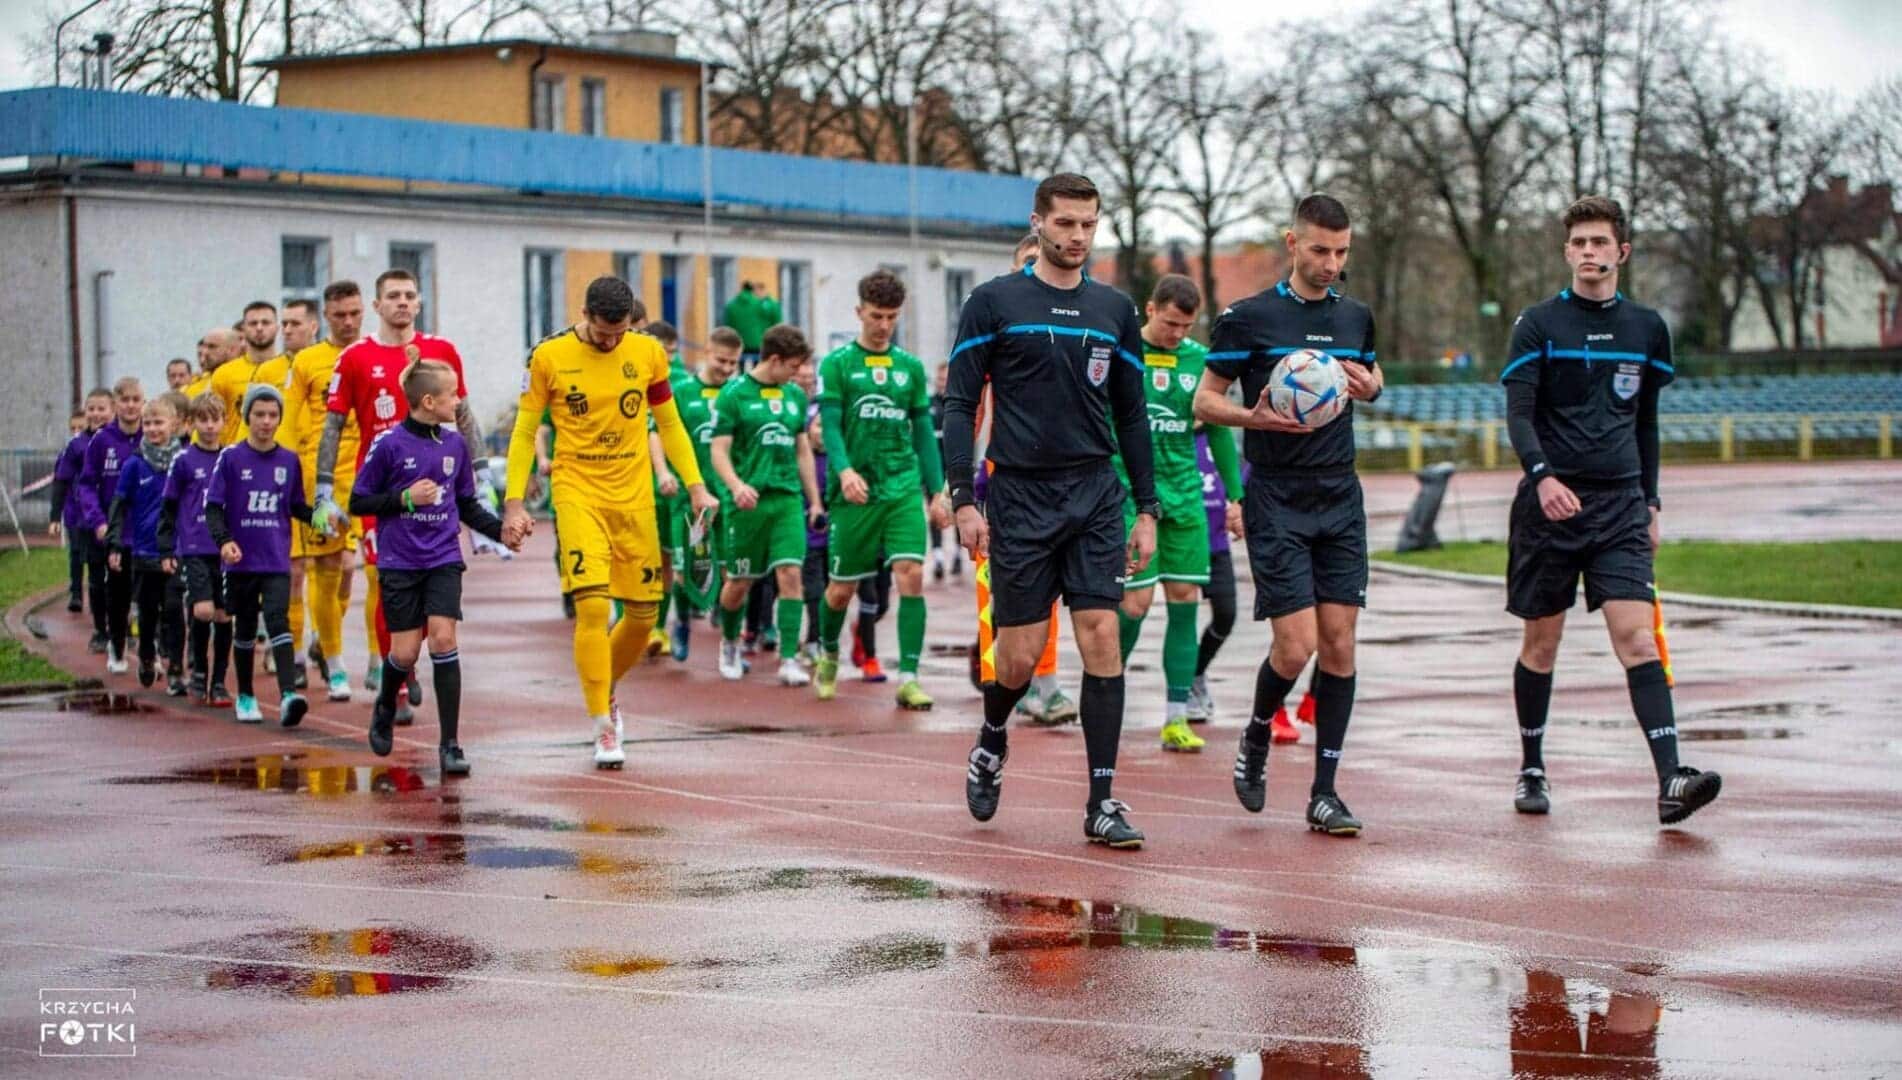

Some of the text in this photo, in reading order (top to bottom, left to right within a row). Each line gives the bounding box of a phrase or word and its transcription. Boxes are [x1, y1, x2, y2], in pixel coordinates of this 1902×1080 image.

[1147, 415, 1188, 432] nea
[247, 490, 279, 513] lit
[569, 549, 586, 576] 2
[1093, 767, 1117, 777] zin
